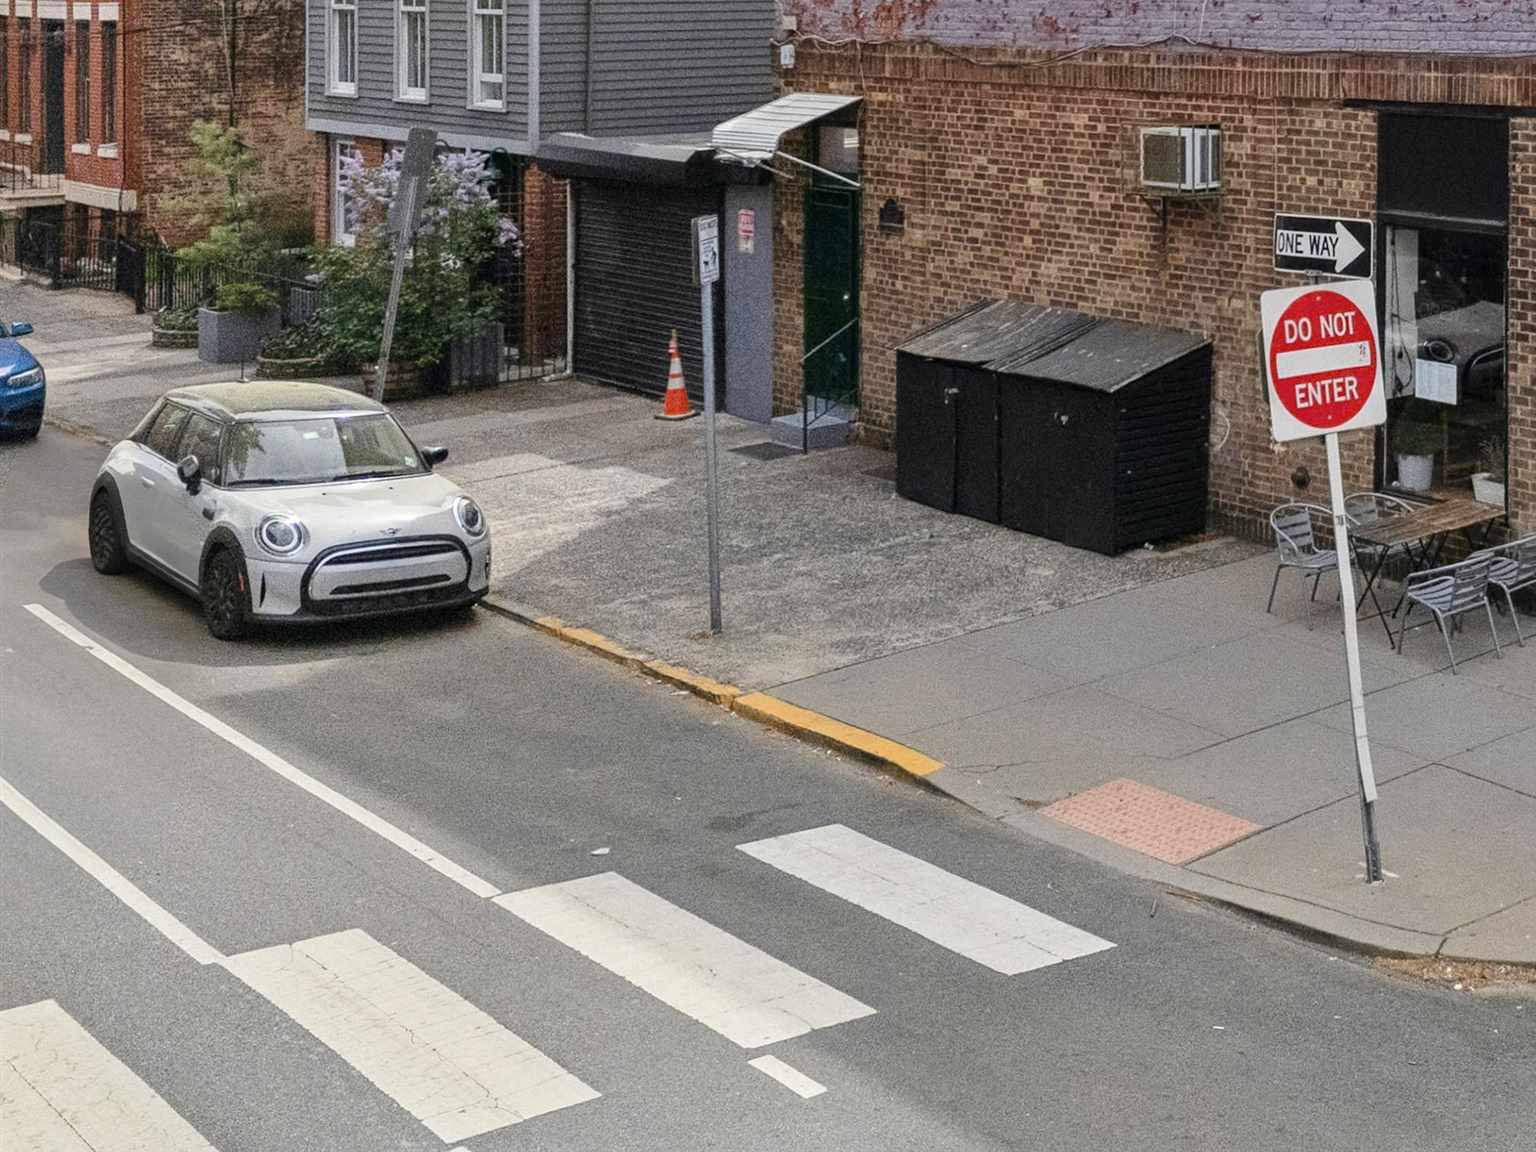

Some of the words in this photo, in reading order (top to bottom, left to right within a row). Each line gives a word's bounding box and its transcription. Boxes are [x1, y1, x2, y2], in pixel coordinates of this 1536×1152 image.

[1277, 232, 1304, 254] ONE
[1309, 234, 1338, 257] WAY
[1284, 318, 1312, 344] DO
[1319, 311, 1356, 339] NOT
[1294, 376, 1359, 409] ENTER
